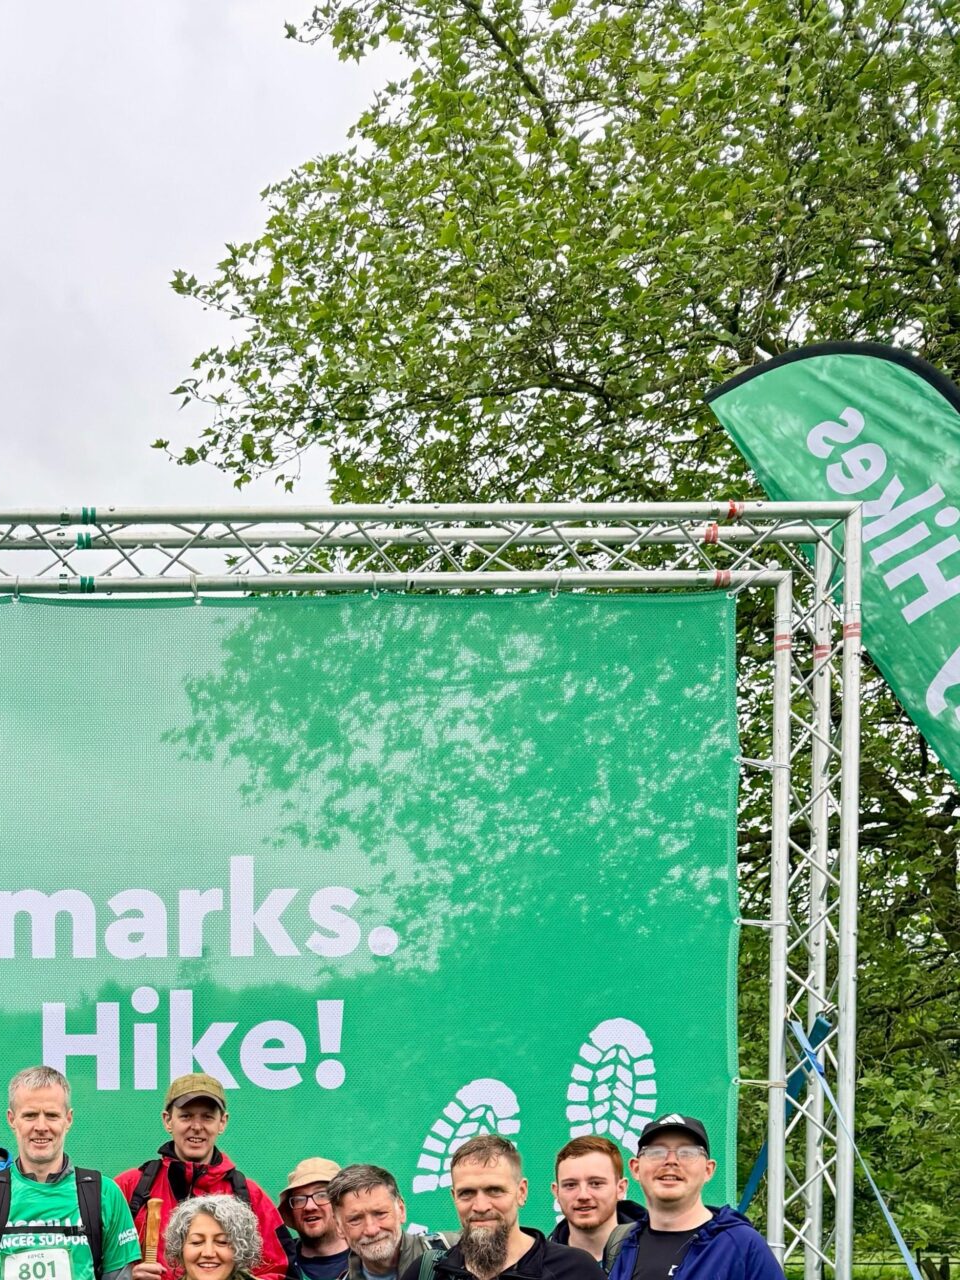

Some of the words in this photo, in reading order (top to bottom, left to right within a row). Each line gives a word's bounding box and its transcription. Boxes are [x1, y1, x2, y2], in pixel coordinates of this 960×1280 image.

[42, 986, 345, 1090] Hike!
[0, 1236, 36, 1250] NCER
[38, 1234, 89, 1246] SUPPOR
[19, 1260, 57, 1280] 801
